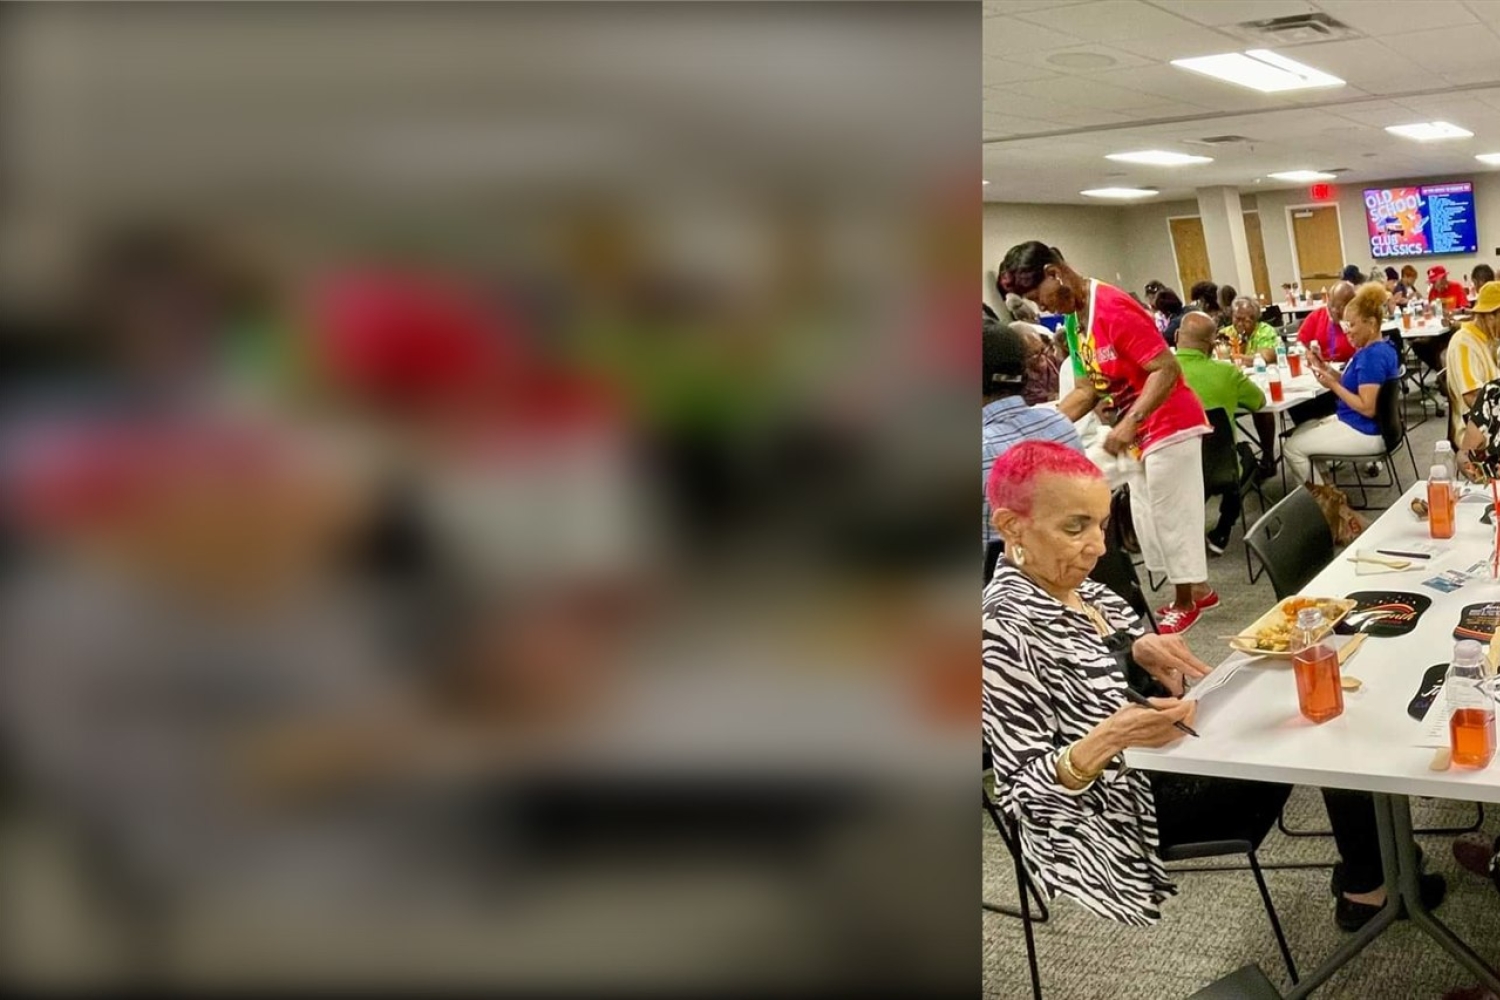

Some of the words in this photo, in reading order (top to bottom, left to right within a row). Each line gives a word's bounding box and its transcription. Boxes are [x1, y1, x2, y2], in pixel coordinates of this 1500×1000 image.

[1366, 190, 1392, 209] OLD
[1370, 193, 1426, 222] SCHOOL
[1371, 235, 1398, 246] CLUB
[1372, 243, 1423, 257] CLASSICS
